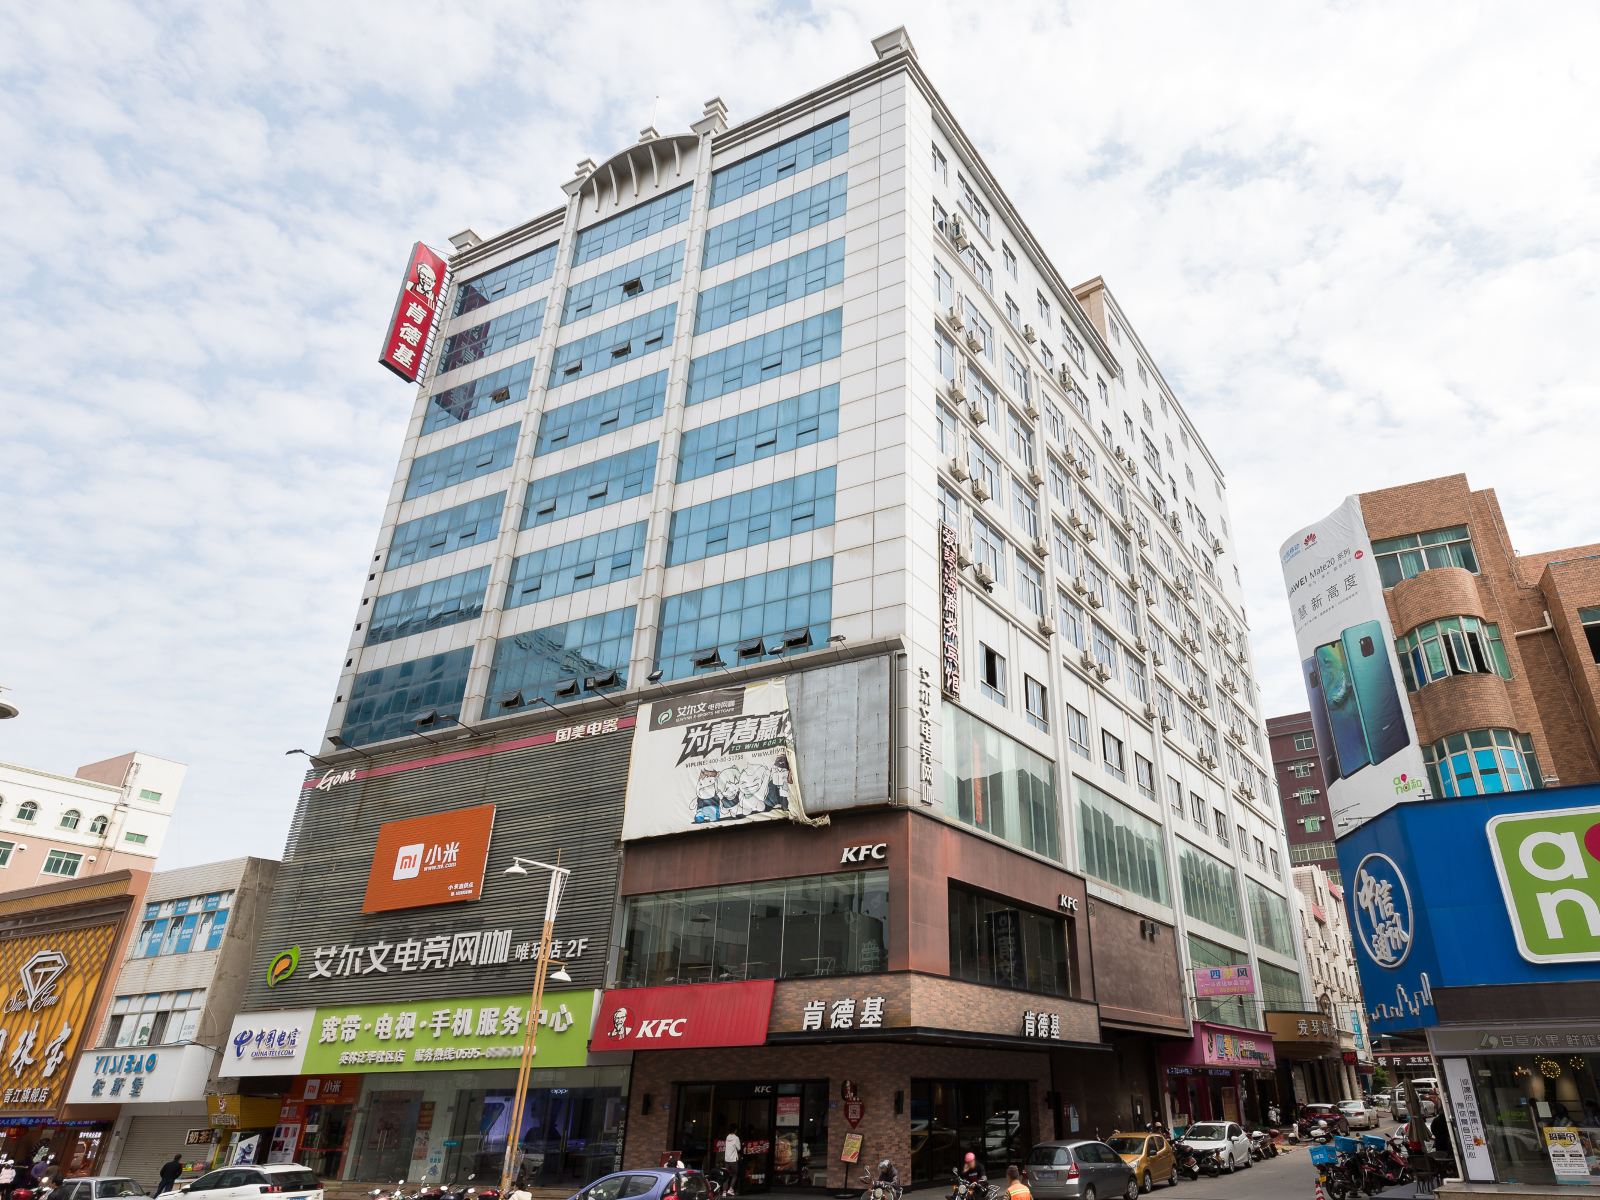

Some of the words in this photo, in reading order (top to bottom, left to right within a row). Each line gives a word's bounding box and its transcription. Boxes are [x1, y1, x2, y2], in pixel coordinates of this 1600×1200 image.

[392, 301, 428, 371] 肯德基
[1309, 557, 1336, 579] Mate20
[1337, 547, 1351, 560] 系列
[677, 702, 707, 717] 艾尔文
[555, 717, 619, 743] 国美电器
[424, 842, 460, 865] 小米
[840, 843, 887, 864] KFC
[423, 862, 457, 871] www.mi.com
[1060, 894, 1079, 911] KFC
[309, 929, 512, 979] 艾尔文电竞网咖
[565, 938, 589, 958] 2F
[802, 996, 886, 1031] 肯德基
[635, 1018, 687, 1039] KFC
[1024, 1011, 1060, 1039] 肯德基
[255, 1028, 298, 1049] 中国电信
[4, 1086, 50, 1104] 晋江旗舰店
[323, 1079, 343, 1093] 小米
[754, 1085, 773, 1093] KFC
